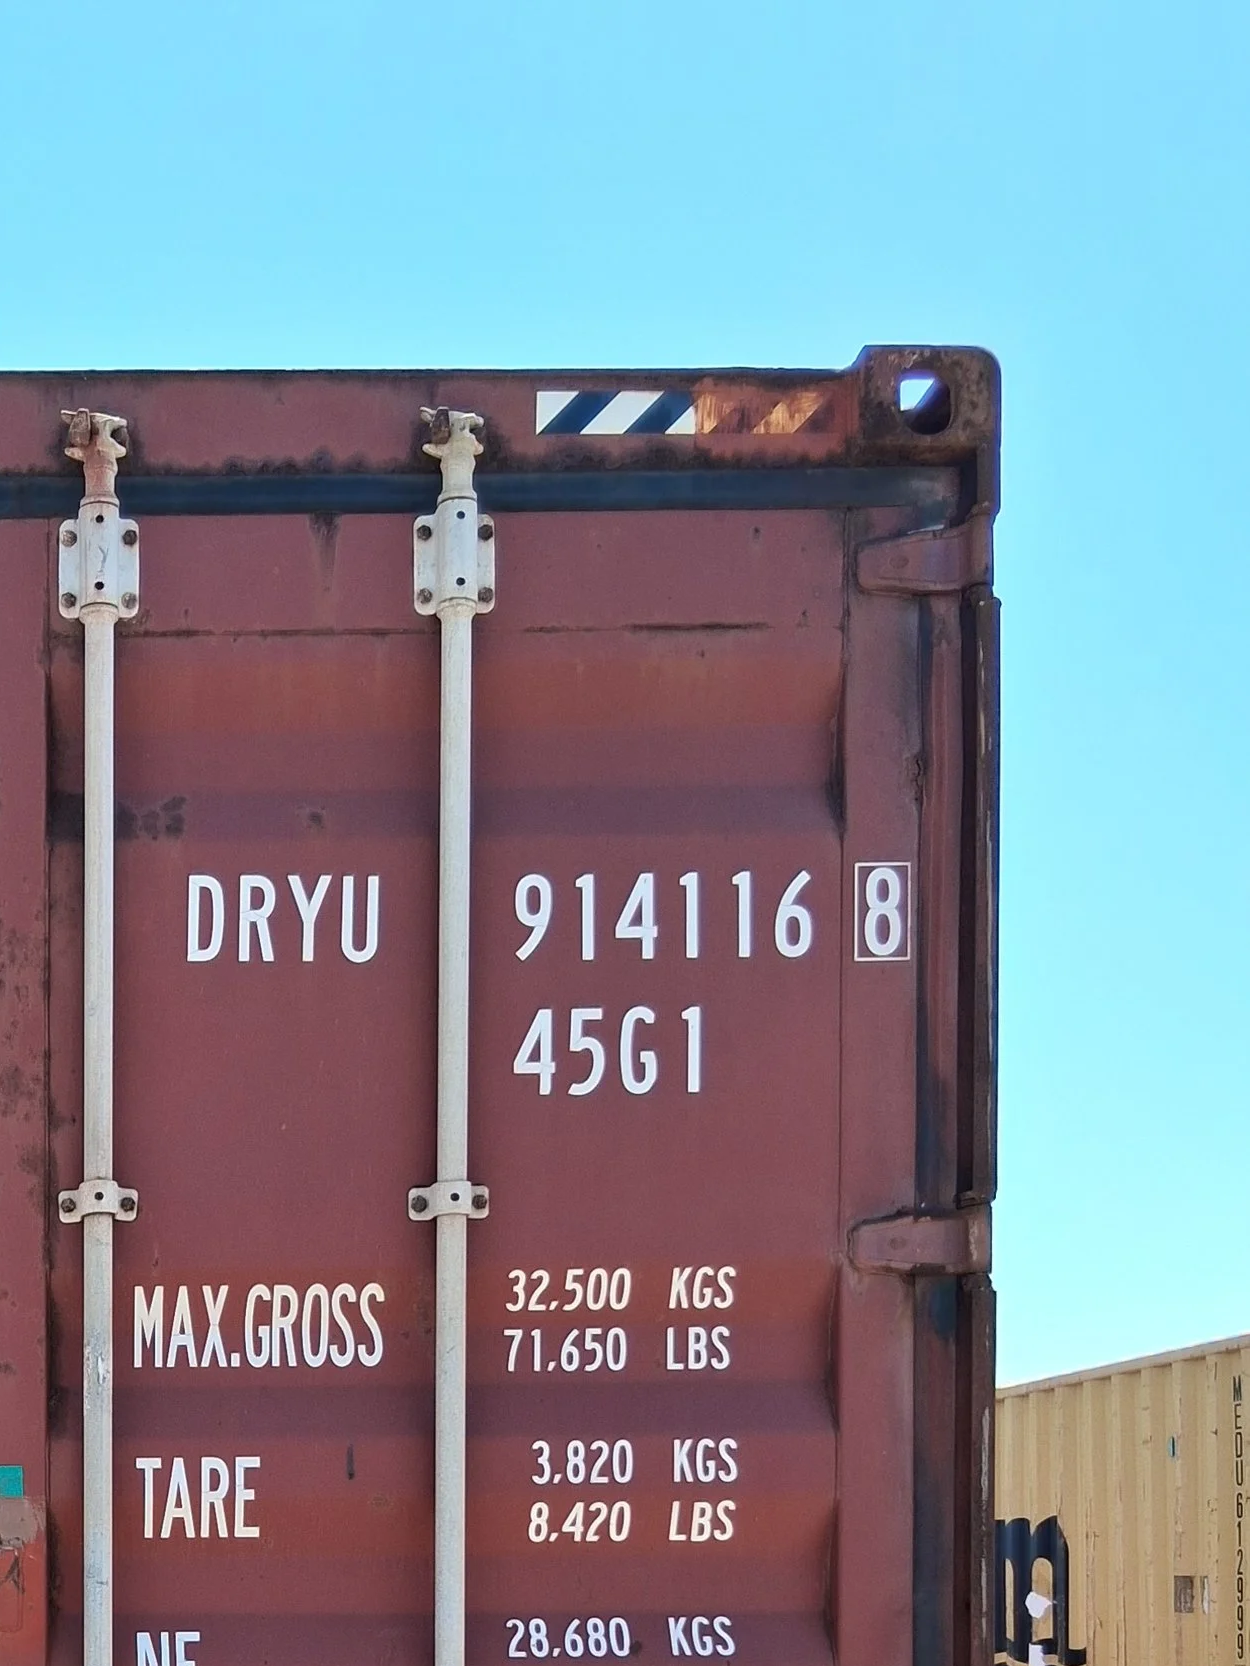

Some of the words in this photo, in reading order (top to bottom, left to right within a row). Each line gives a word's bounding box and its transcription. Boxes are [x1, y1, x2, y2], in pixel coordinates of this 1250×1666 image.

[187, 875, 379, 963] DRYU
[516, 871, 812, 960] 914116
[863, 868, 903, 957] 8
[514, 1006, 700, 1095] 45G1
[134, 1283, 384, 1367] MAX.GROSS
[669, 1266, 736, 1308] KGS
[667, 1326, 730, 1369] LBS
[1232, 1375, 1244, 1487] MEDU
[136, 1457, 260, 1538] TARE
[674, 1438, 737, 1482] KGS
[669, 1500, 735, 1541] LBS
[1236, 1493, 1244, 1660] 612999
[668, 1616, 735, 1656] KGS
